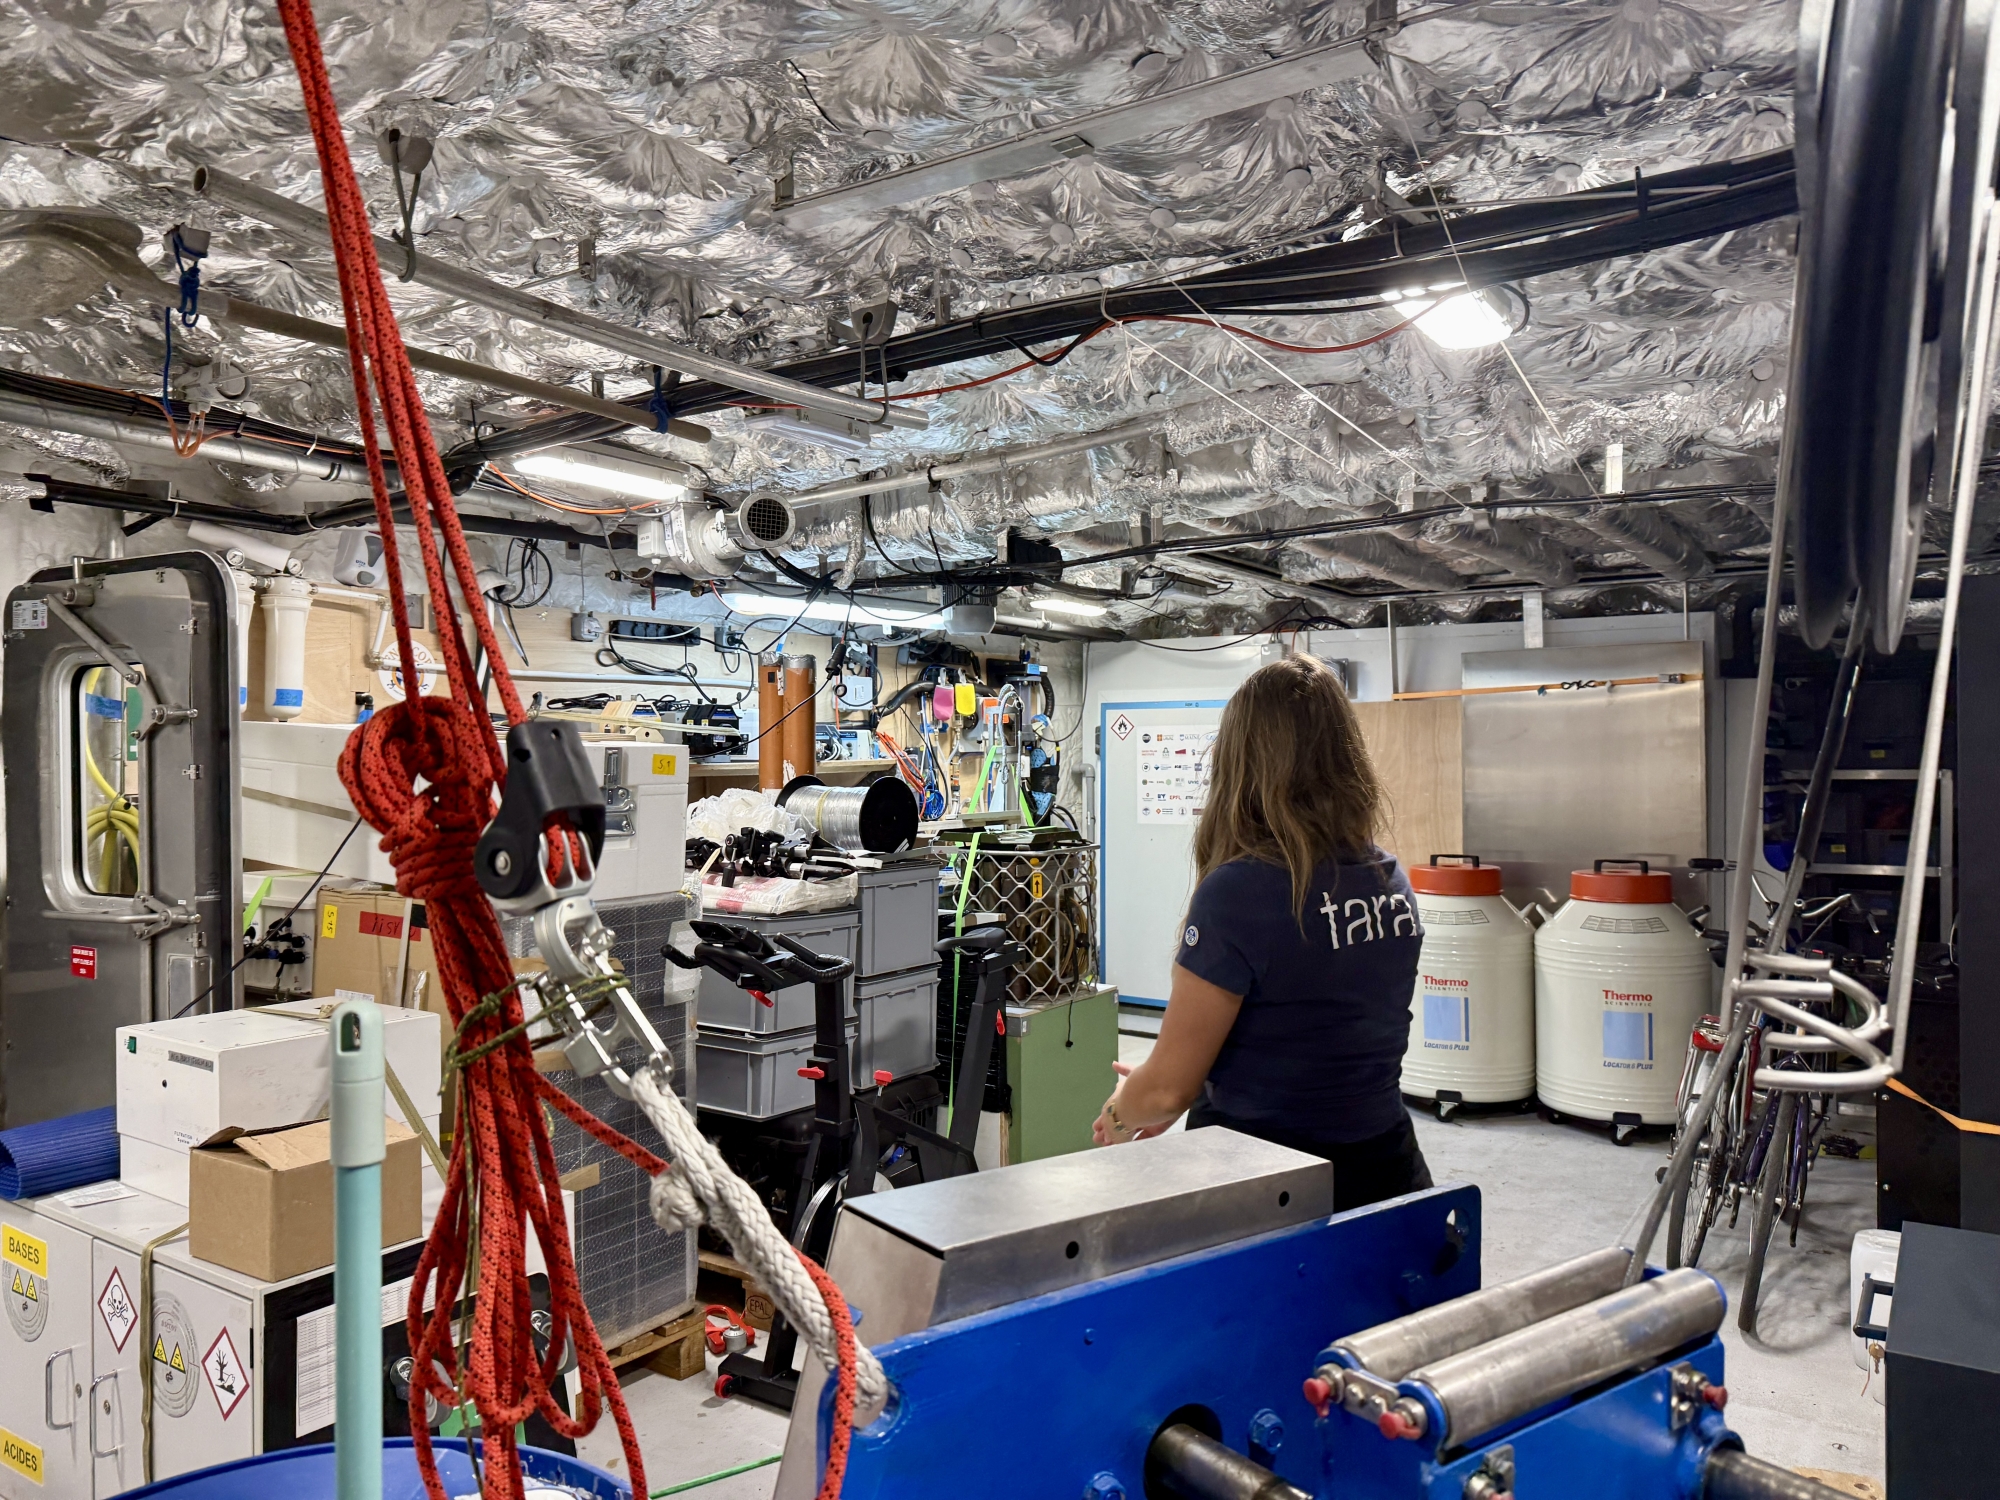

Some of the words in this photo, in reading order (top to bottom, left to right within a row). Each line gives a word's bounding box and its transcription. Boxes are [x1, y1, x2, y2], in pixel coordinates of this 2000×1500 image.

[1319, 891, 1417, 950] tara
[1422, 975, 1469, 987] Thermo
[1602, 989, 1653, 1002] Thermo
[9, 1236, 40, 1265] BASES
[750, 1299, 770, 1316] EPAL
[3, 1440, 37, 1472] ACIDES
